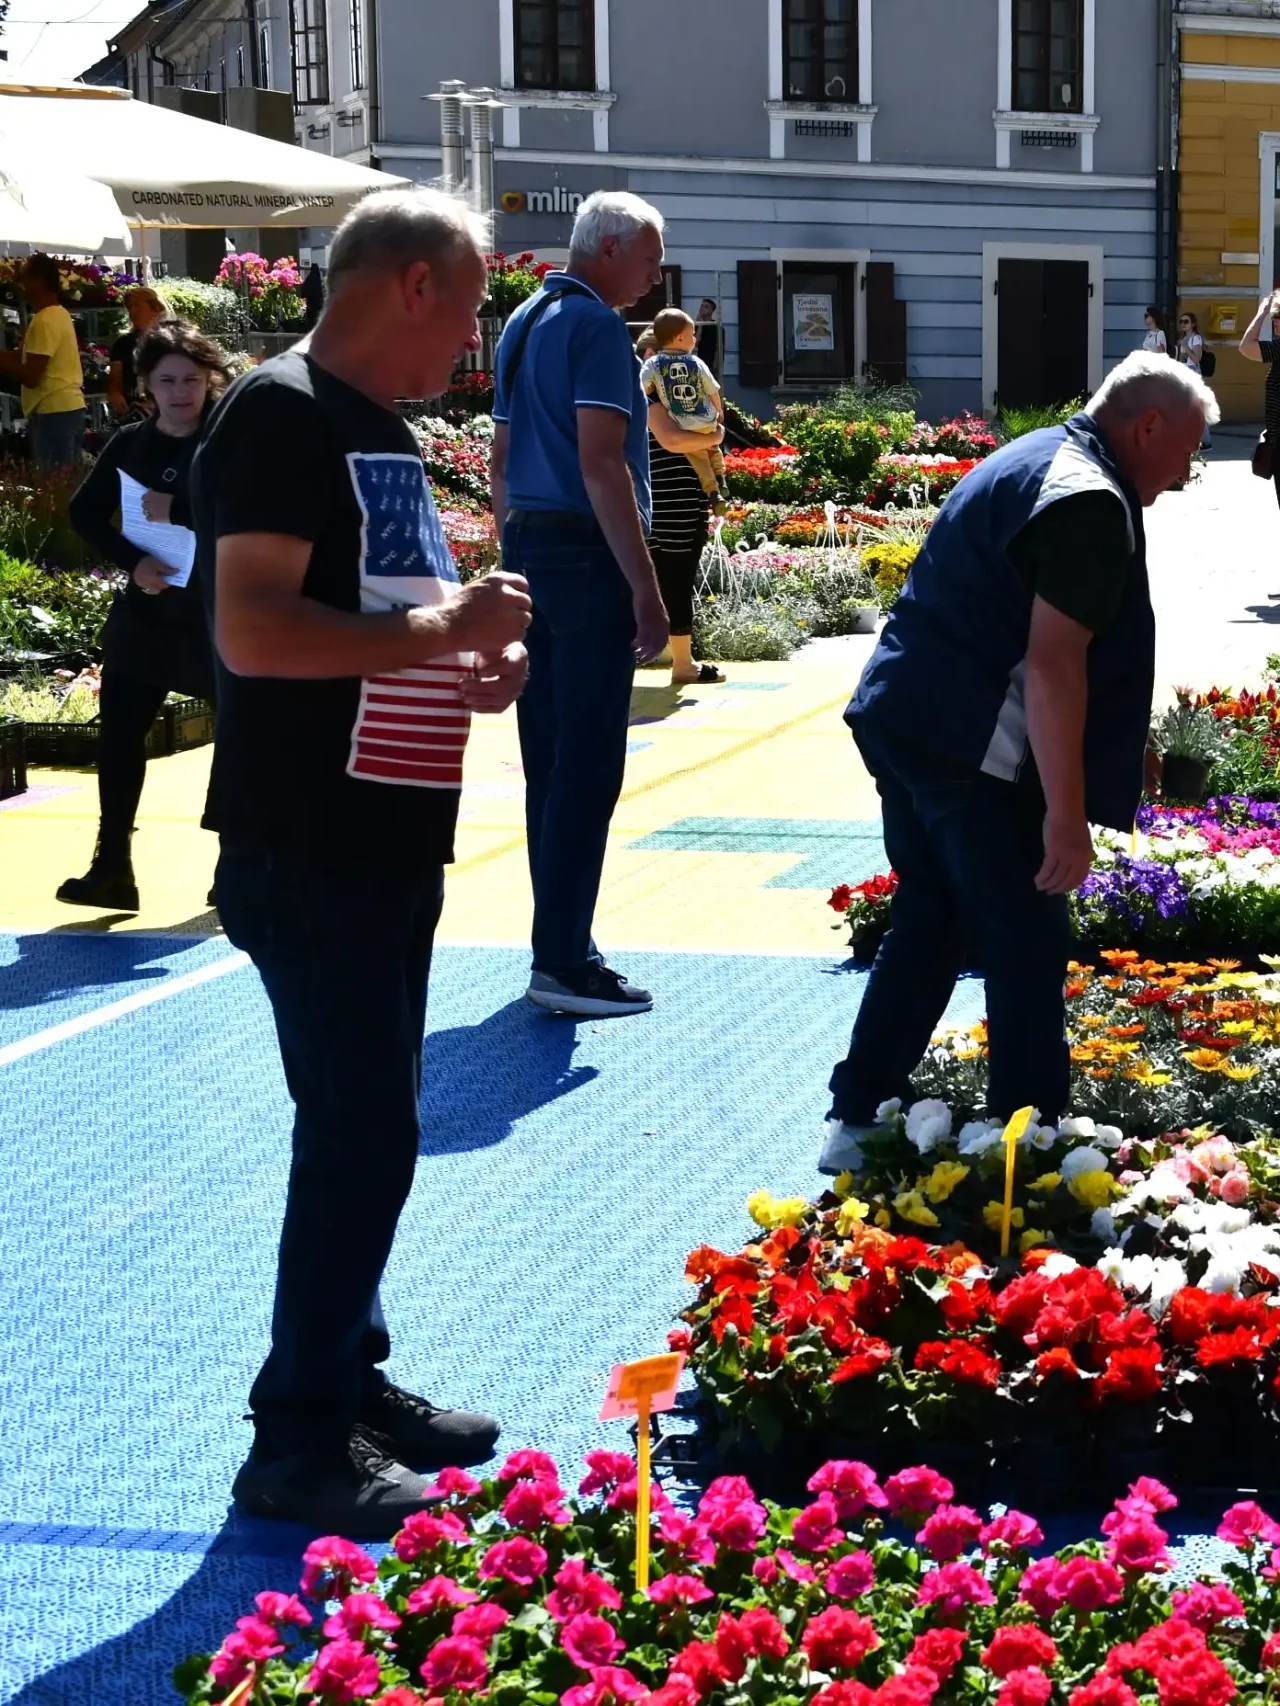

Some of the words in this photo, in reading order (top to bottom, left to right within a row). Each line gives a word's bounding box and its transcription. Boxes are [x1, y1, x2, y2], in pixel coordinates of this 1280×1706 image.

[132, 191, 204, 206] CARBONATED
[206, 193, 253, 207] NATURAL
[254, 195, 299, 208] MINERAL
[299, 195, 334, 208] WATER
[527, 186, 584, 213] mlin
